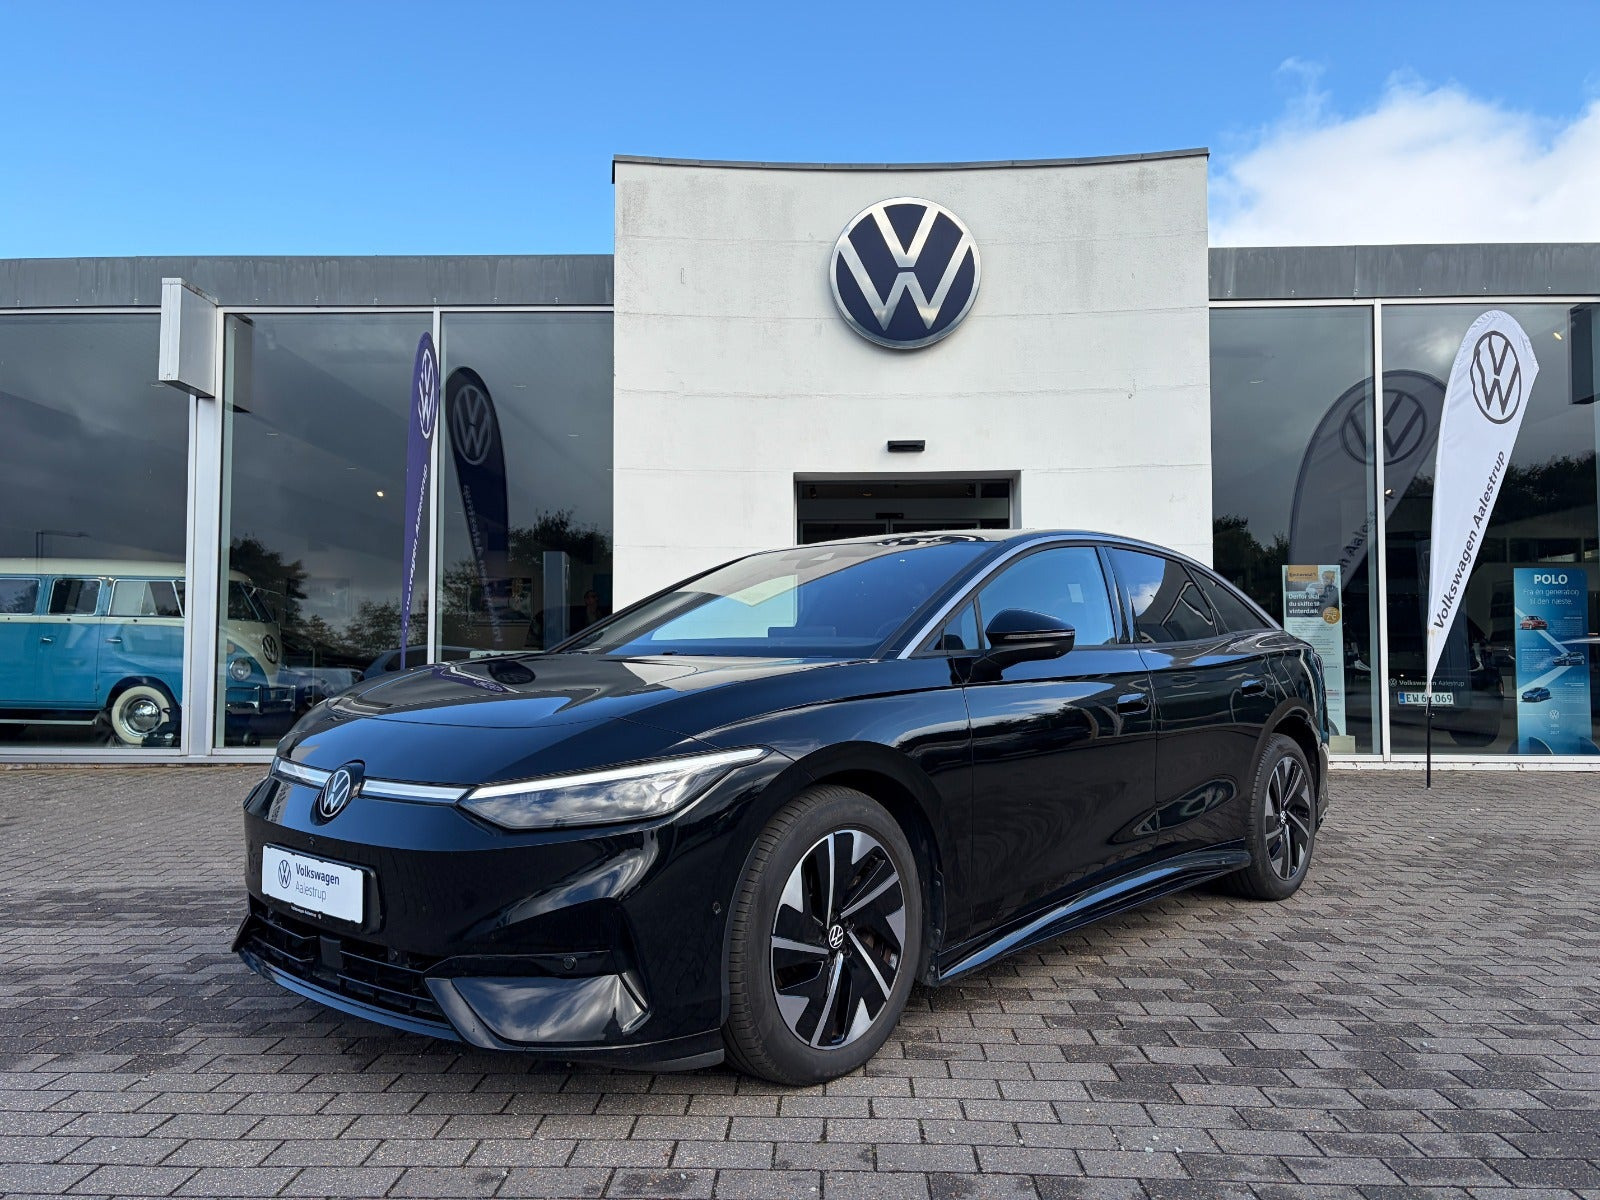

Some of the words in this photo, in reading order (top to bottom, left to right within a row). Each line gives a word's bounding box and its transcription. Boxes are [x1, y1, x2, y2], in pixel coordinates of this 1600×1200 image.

[830, 197, 981, 349] VW
[1470, 331, 1521, 424] VW
[1433, 530, 1478, 629] Volkswagen
[1472, 450, 1505, 530] Aalestrup
[1533, 574, 1568, 585] POLO
[1406, 694, 1419, 703] EW
[1435, 694, 1452, 703] 069
[319, 769, 350, 818] VW
[278, 859, 292, 889] VW
[295, 862, 340, 887] Volkswagen
[295, 880, 327, 902] Aalestrup
